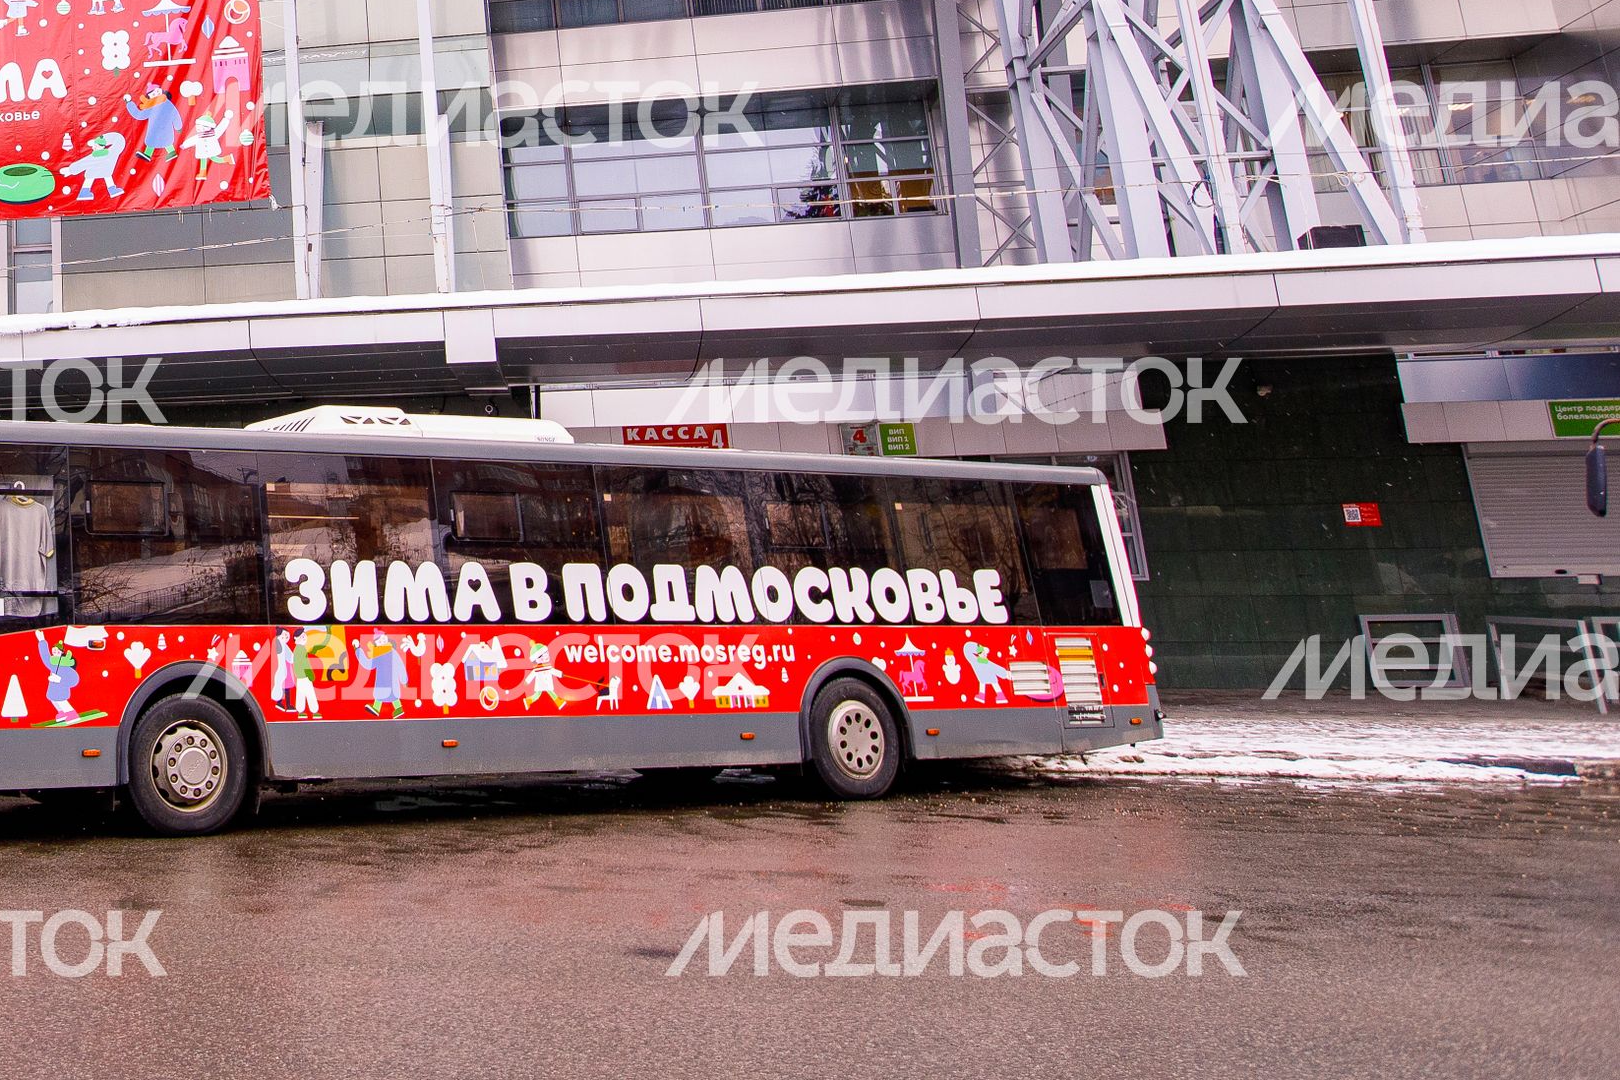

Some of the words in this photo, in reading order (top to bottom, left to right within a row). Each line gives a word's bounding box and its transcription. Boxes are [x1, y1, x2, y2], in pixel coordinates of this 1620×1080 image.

[1554, 405, 1584, 413] Центр
[626, 426, 708, 441] КАССА
[711, 429, 724, 449] 4
[852, 429, 868, 444] 4
[286, 558, 501, 623] ЗИМА
[511, 562, 556, 622] В
[563, 561, 1010, 624] ПОДМОСКОВЬЕ
[564, 640, 795, 670] welcome.mosreg.ru
